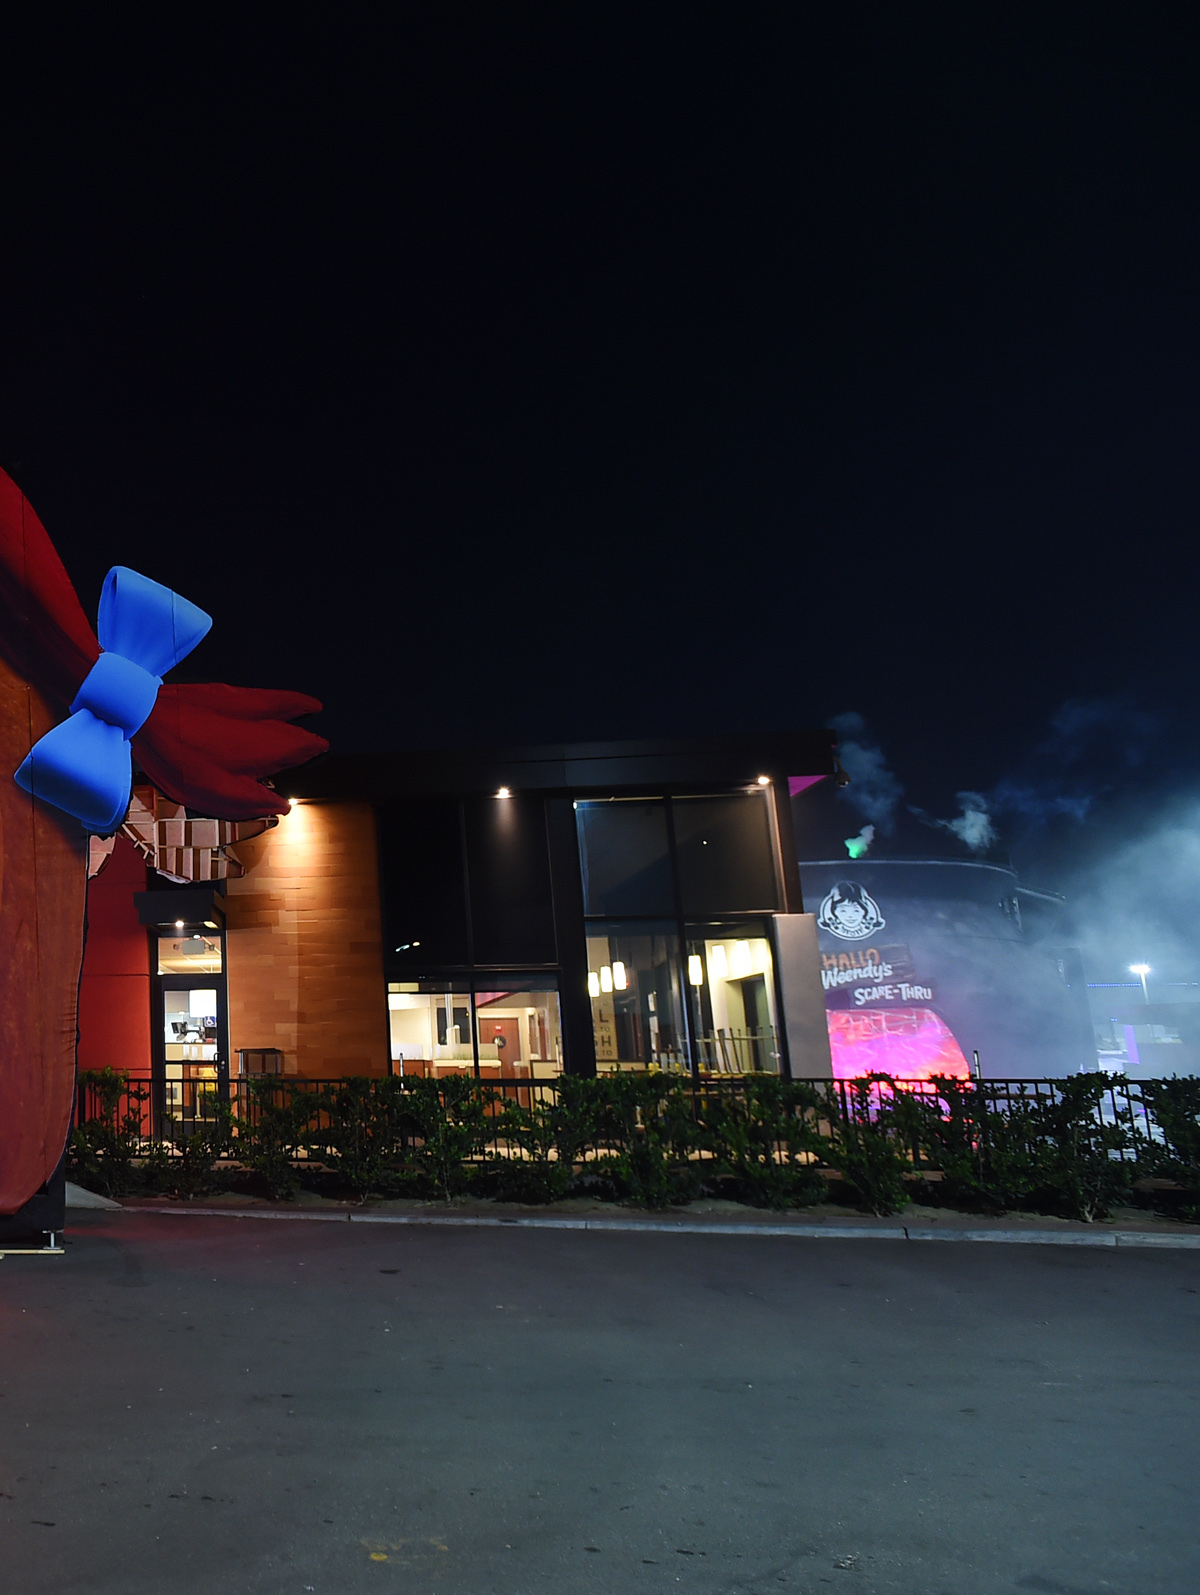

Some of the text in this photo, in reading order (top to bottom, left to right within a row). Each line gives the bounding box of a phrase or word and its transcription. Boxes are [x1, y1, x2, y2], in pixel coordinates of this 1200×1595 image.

[822, 947, 881, 970] HALLO
[820, 959, 893, 990] Weendy's
[854, 982, 932, 1006] SCARE-THRU
